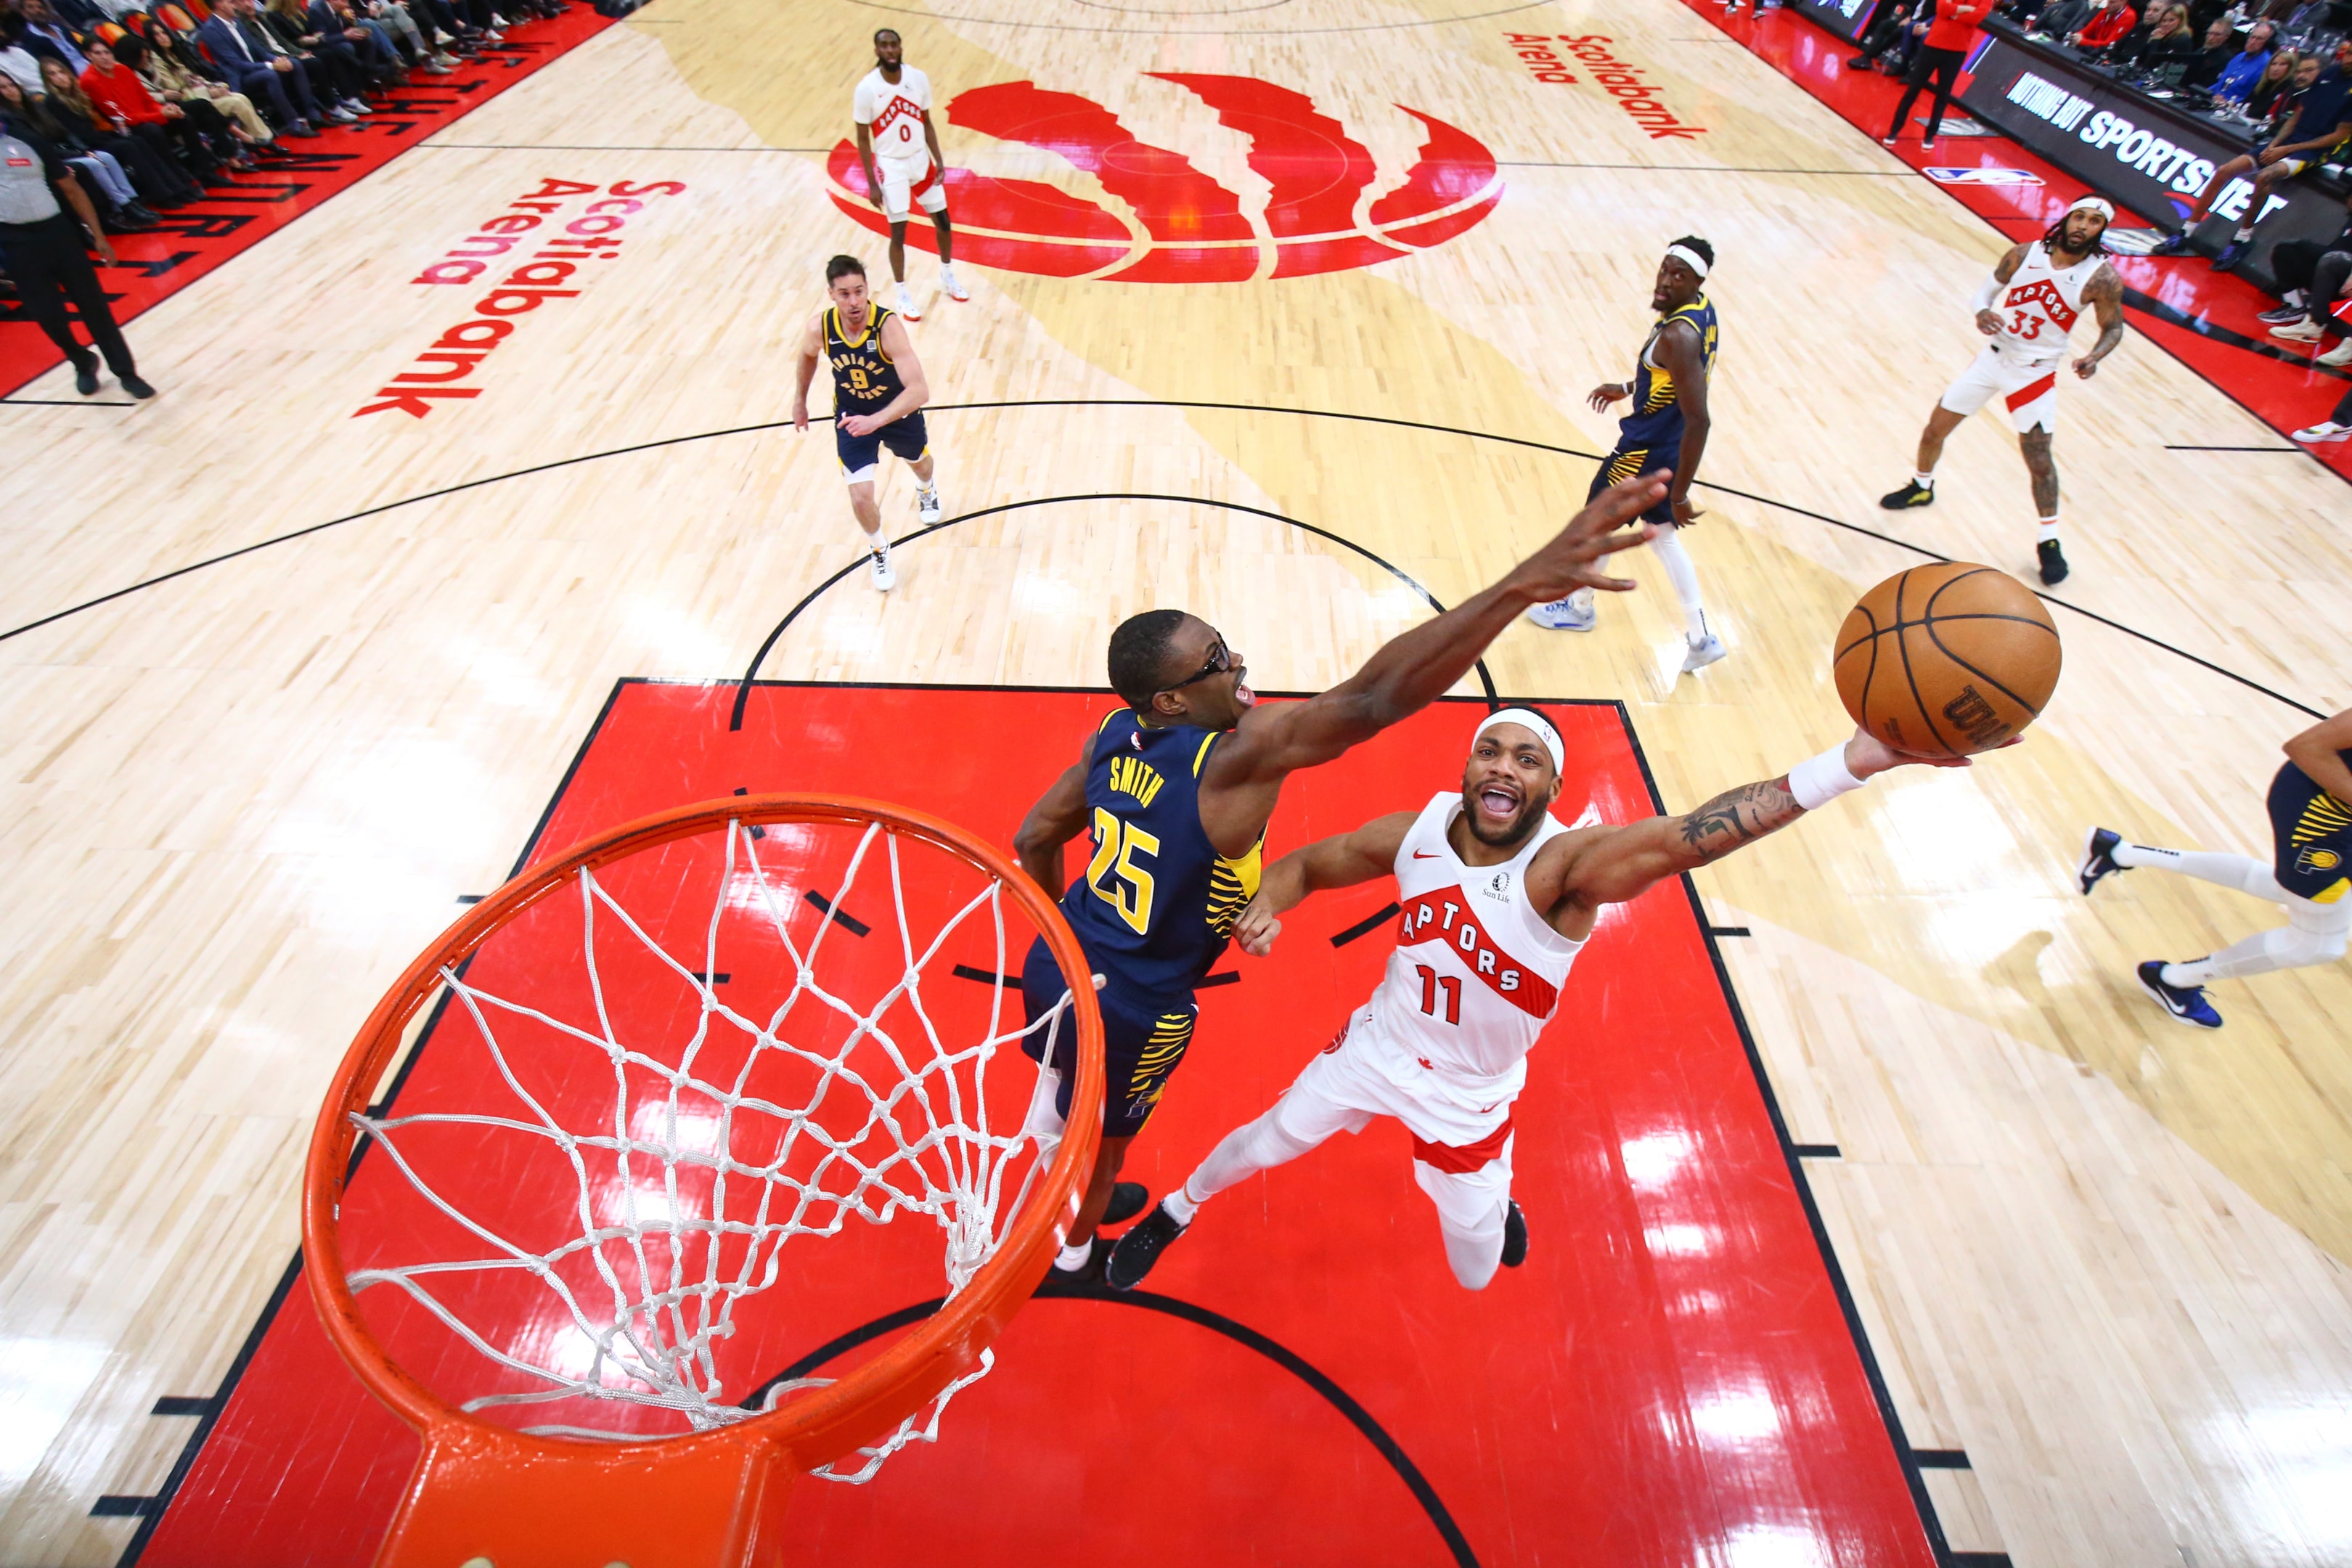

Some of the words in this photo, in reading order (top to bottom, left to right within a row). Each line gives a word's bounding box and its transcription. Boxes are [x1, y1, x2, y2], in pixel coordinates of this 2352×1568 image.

[1502, 33, 1578, 83] Arena
[879, 99, 921, 128] RAPTORS
[1558, 35, 1708, 140] Scotiabank
[2005, 71, 2070, 121] NOTHING
[2050, 94, 2096, 132] BUT
[899, 123, 911, 142] 0
[409, 177, 600, 284] Arena
[348, 180, 687, 419] Scotiabank
[2007, 309, 2046, 340] 33
[849, 369, 869, 390] 9
[1109, 756, 1164, 808] SMITH
[1087, 806, 1161, 936] 25
[1482, 888, 1496, 899] Sun
[1497, 893, 1510, 904] Life
[1402, 900, 1519, 992] APTORS
[1415, 964, 1462, 1026] 11
